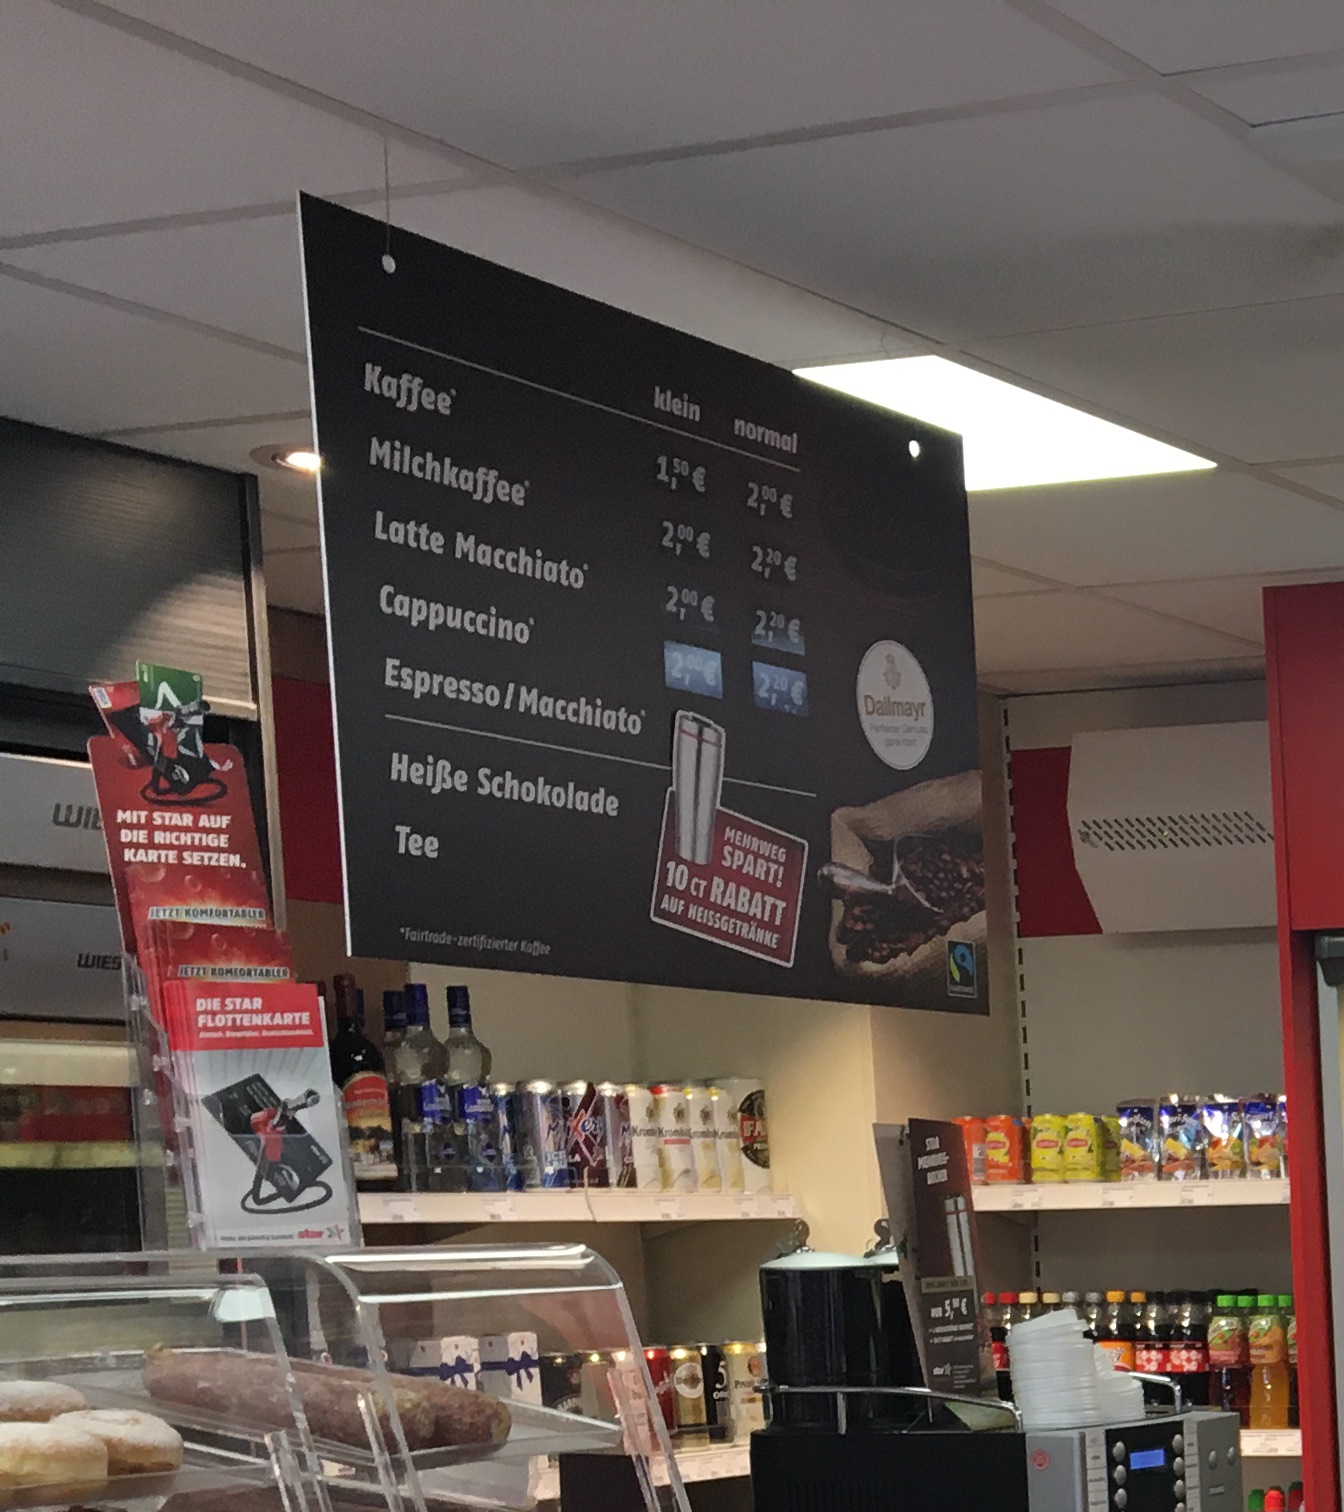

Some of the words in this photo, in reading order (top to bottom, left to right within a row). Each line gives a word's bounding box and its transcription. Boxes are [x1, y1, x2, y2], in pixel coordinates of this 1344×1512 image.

[654, 386, 700, 422] klein
[734, 417, 798, 453] normal
[374, 511, 444, 554] Latte
[385, 657, 500, 710] Espresso
[864, 695, 926, 721] Dallmayr
[390, 752, 468, 794] Heiße
[477, 769, 620, 817] Schokolade
[116, 809, 147, 824] MIT
[152, 811, 193, 826] STAR
[199, 814, 231, 829] AUF
[120, 829, 148, 843] DIE
[154, 832, 229, 848] RICHTIGE
[395, 825, 439, 859] Tee
[725, 826, 786, 862] MEHRWEG
[124, 848, 178, 864] KARTE
[182, 851, 246, 868] SETZEN.
[722, 846, 783, 887] SPART!
[666, 861, 687, 888] 10
[710, 877, 787, 926] RABATT
[660, 895, 685, 915] AUF
[687, 900, 780, 949] HEISSGETRÄNKE
[520, 938, 551, 957] Kaffee
[196, 998, 221, 1011] DIE
[224, 998, 262, 1010] STAR
[198, 1013, 310, 1027] FLOTTENKARTE
